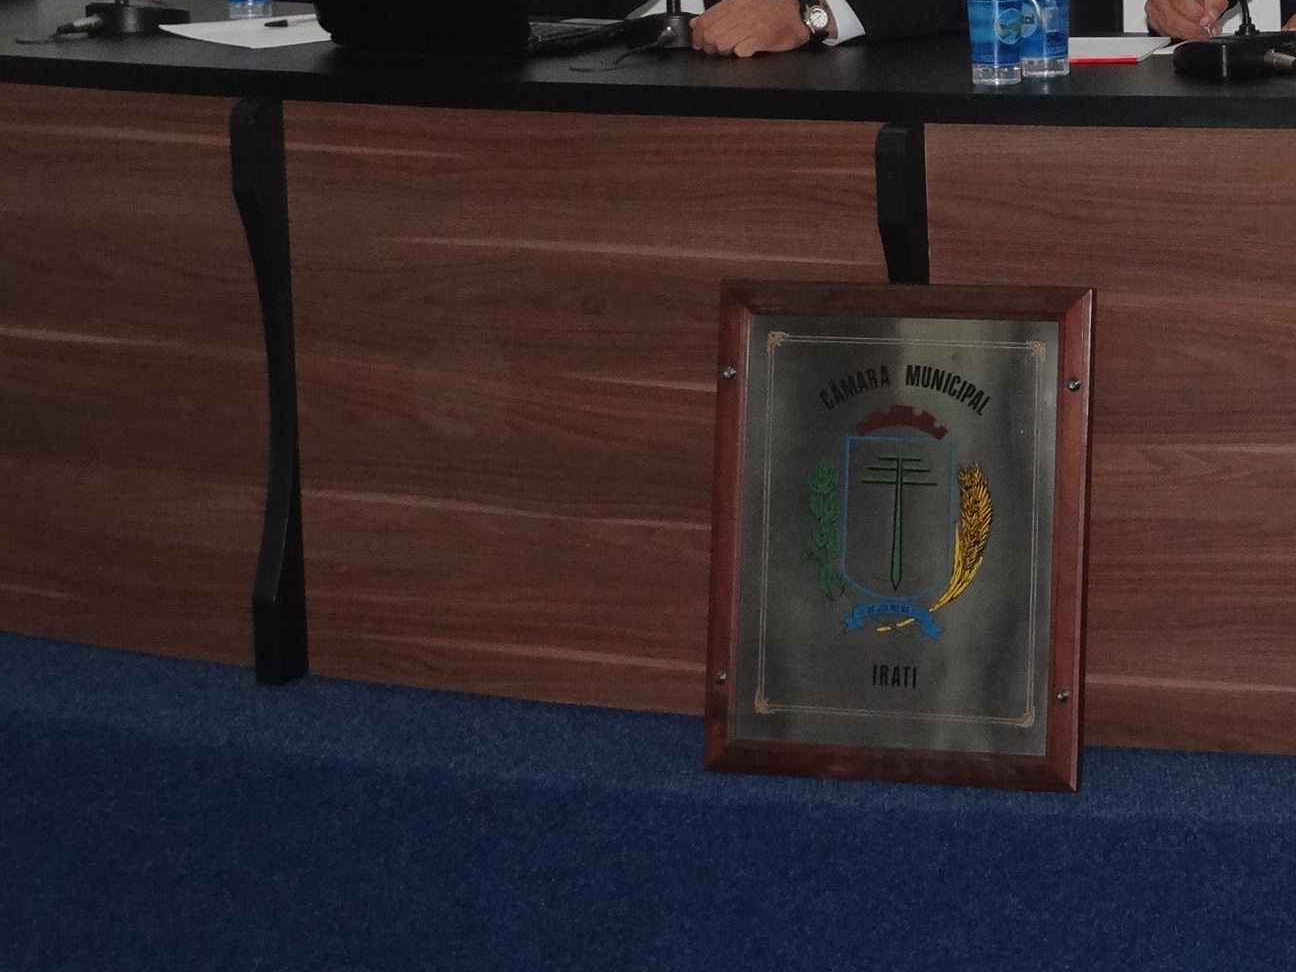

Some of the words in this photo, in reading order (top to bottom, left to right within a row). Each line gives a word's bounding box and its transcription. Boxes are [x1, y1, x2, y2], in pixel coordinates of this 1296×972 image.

[819, 364, 891, 411] CÂMARA
[905, 364, 991, 416] MUNICIPAL
[871, 663, 918, 688] IRATI
